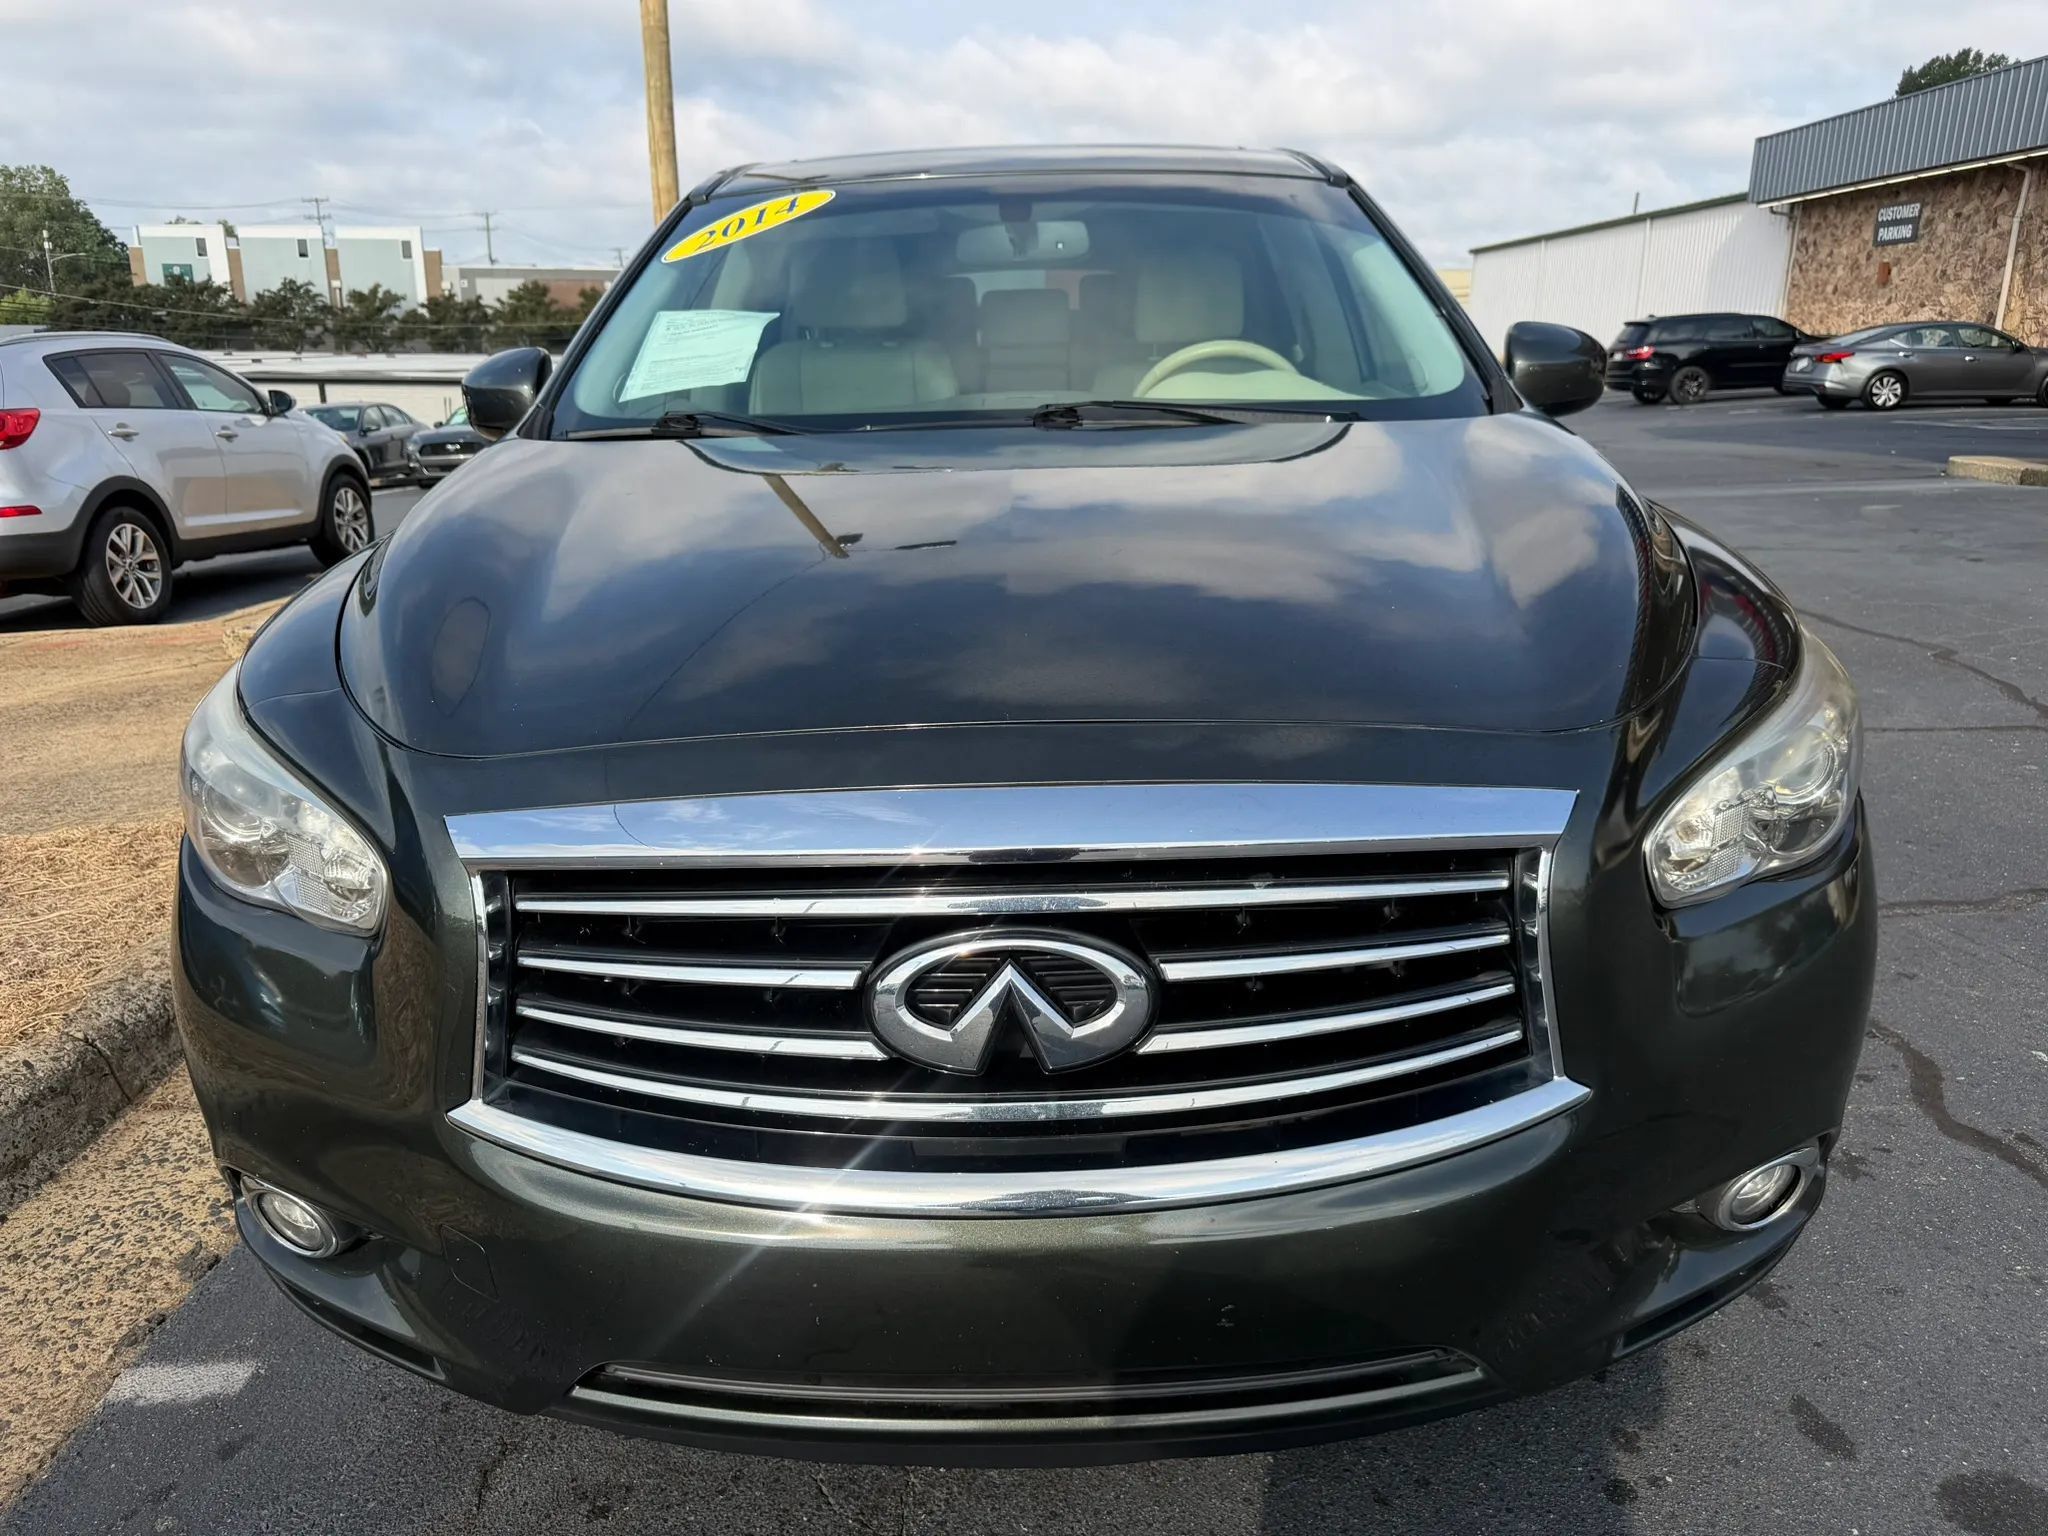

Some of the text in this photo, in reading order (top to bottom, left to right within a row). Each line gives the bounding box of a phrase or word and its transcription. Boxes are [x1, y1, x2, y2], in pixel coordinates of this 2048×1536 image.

[1878, 203, 1920, 222] CUSTOMER
[695, 196, 800, 251] 2014
[1877, 224, 1912, 241] PARKING
